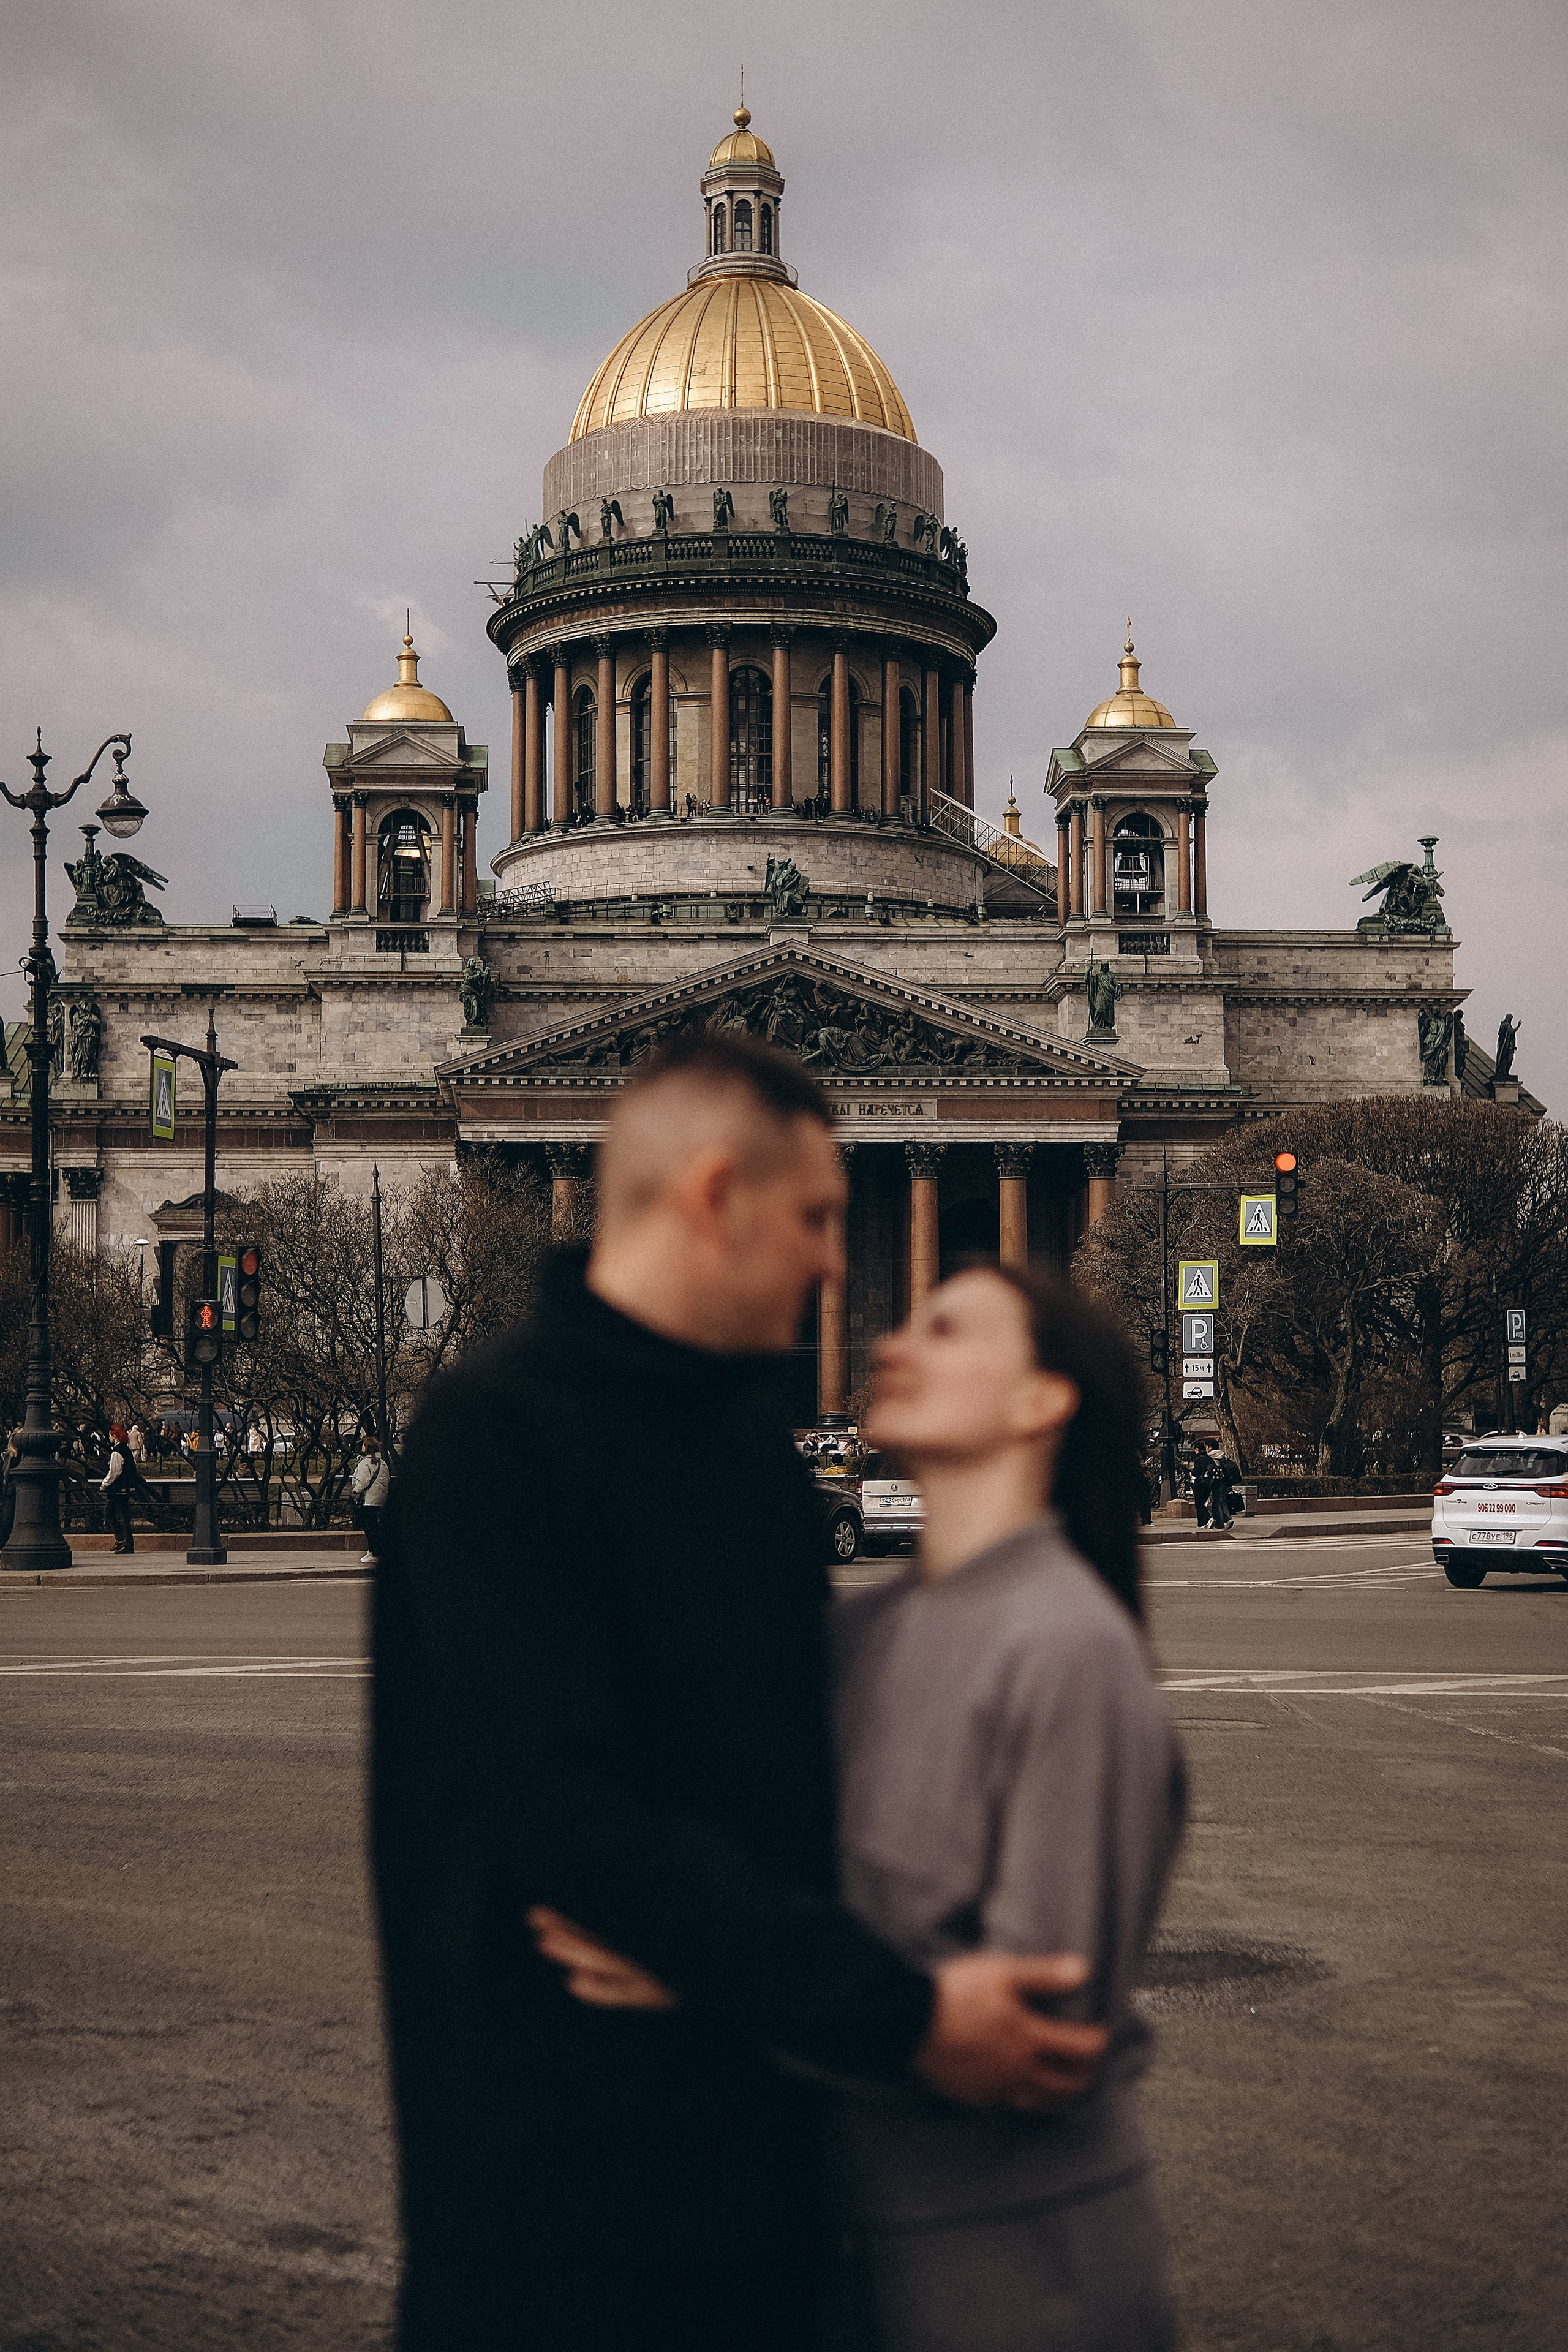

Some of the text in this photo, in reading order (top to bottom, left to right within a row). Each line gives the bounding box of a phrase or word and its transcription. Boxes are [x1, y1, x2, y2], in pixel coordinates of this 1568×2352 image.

[1191, 1319, 1208, 1349] P
[1512, 1313, 1521, 1338] P
[1477, 1503, 1516, 1513] 906 22 99 000
[1472, 1532, 1500, 1540] С778УЕ
